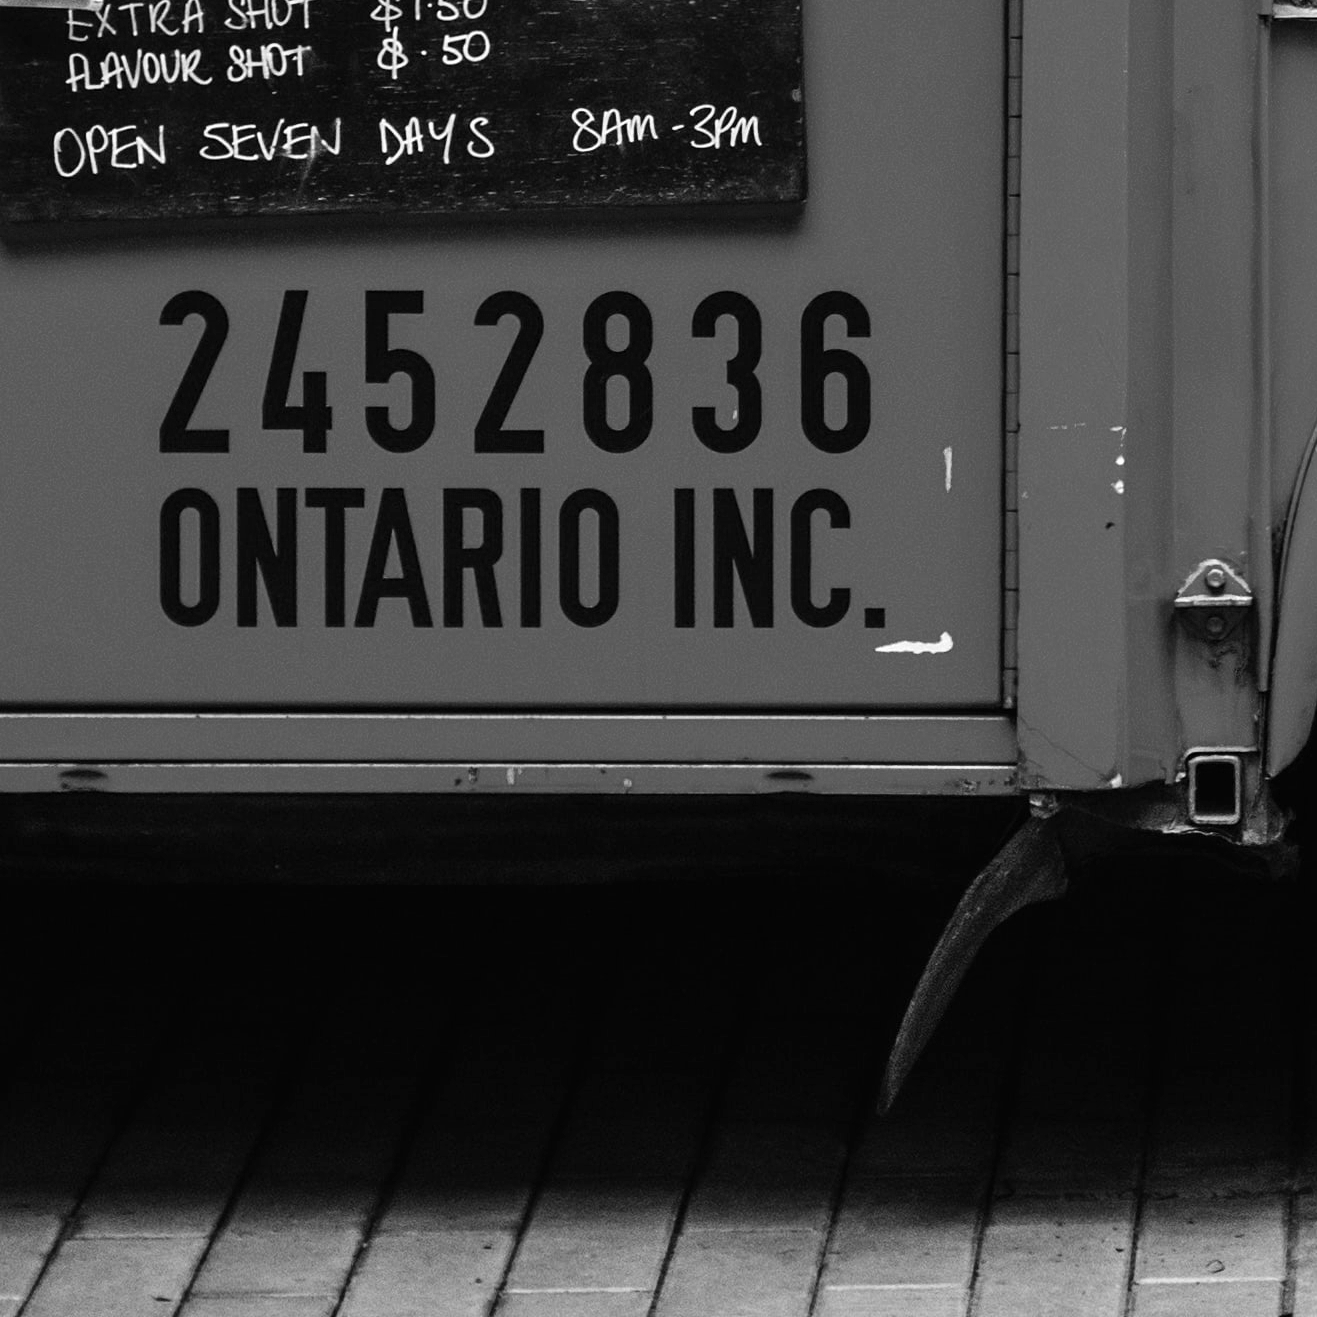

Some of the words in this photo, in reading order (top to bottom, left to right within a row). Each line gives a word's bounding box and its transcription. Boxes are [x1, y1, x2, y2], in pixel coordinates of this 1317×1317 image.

[65, 47, 213, 92] FLAVOUR
[226, 42, 313, 84] SHOT
[52, 123, 167, 178] OPEN
[199, 116, 343, 162] SEVEN
[378, 112, 496, 166] DAYS
[157, 288, 873, 455] 2452836
[157, 486, 622, 630] ONTARIO
[672, 486, 888, 630] INC.
